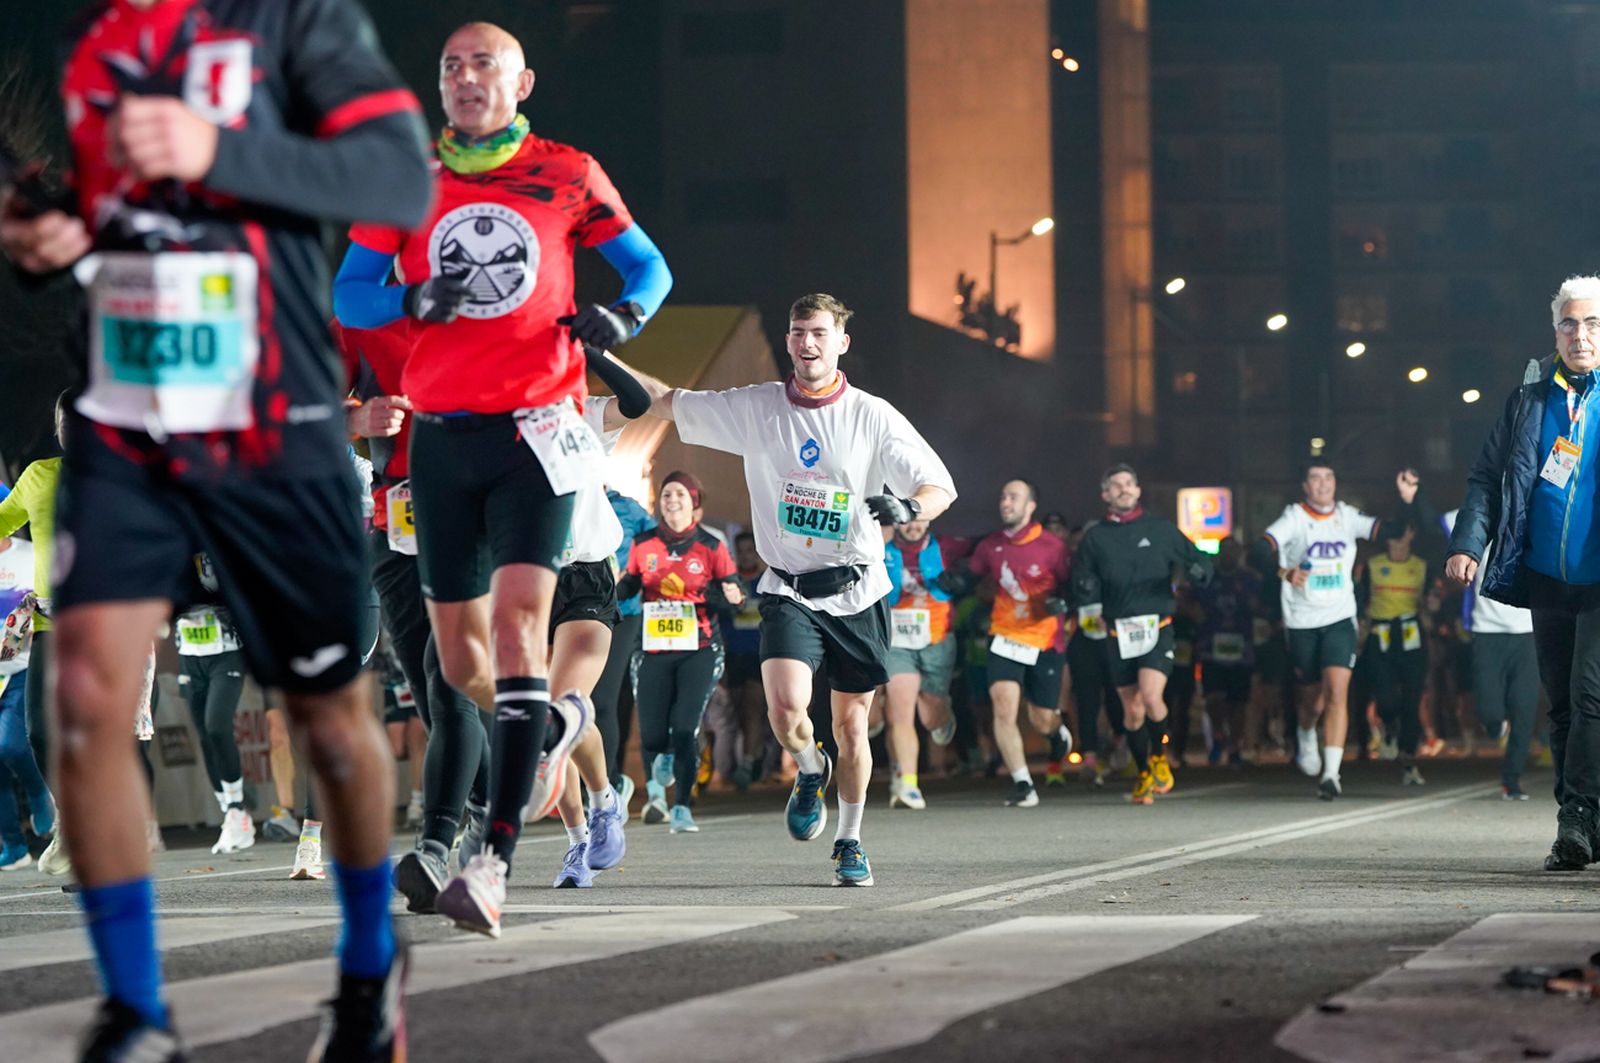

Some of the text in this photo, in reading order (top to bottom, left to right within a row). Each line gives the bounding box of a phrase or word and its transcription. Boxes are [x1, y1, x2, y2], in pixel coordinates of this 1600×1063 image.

[784, 496, 799, 504] SAN
[794, 489, 827, 500] NOCHE DE
[786, 505, 841, 533] 13475
[658, 619, 683, 633] 646
